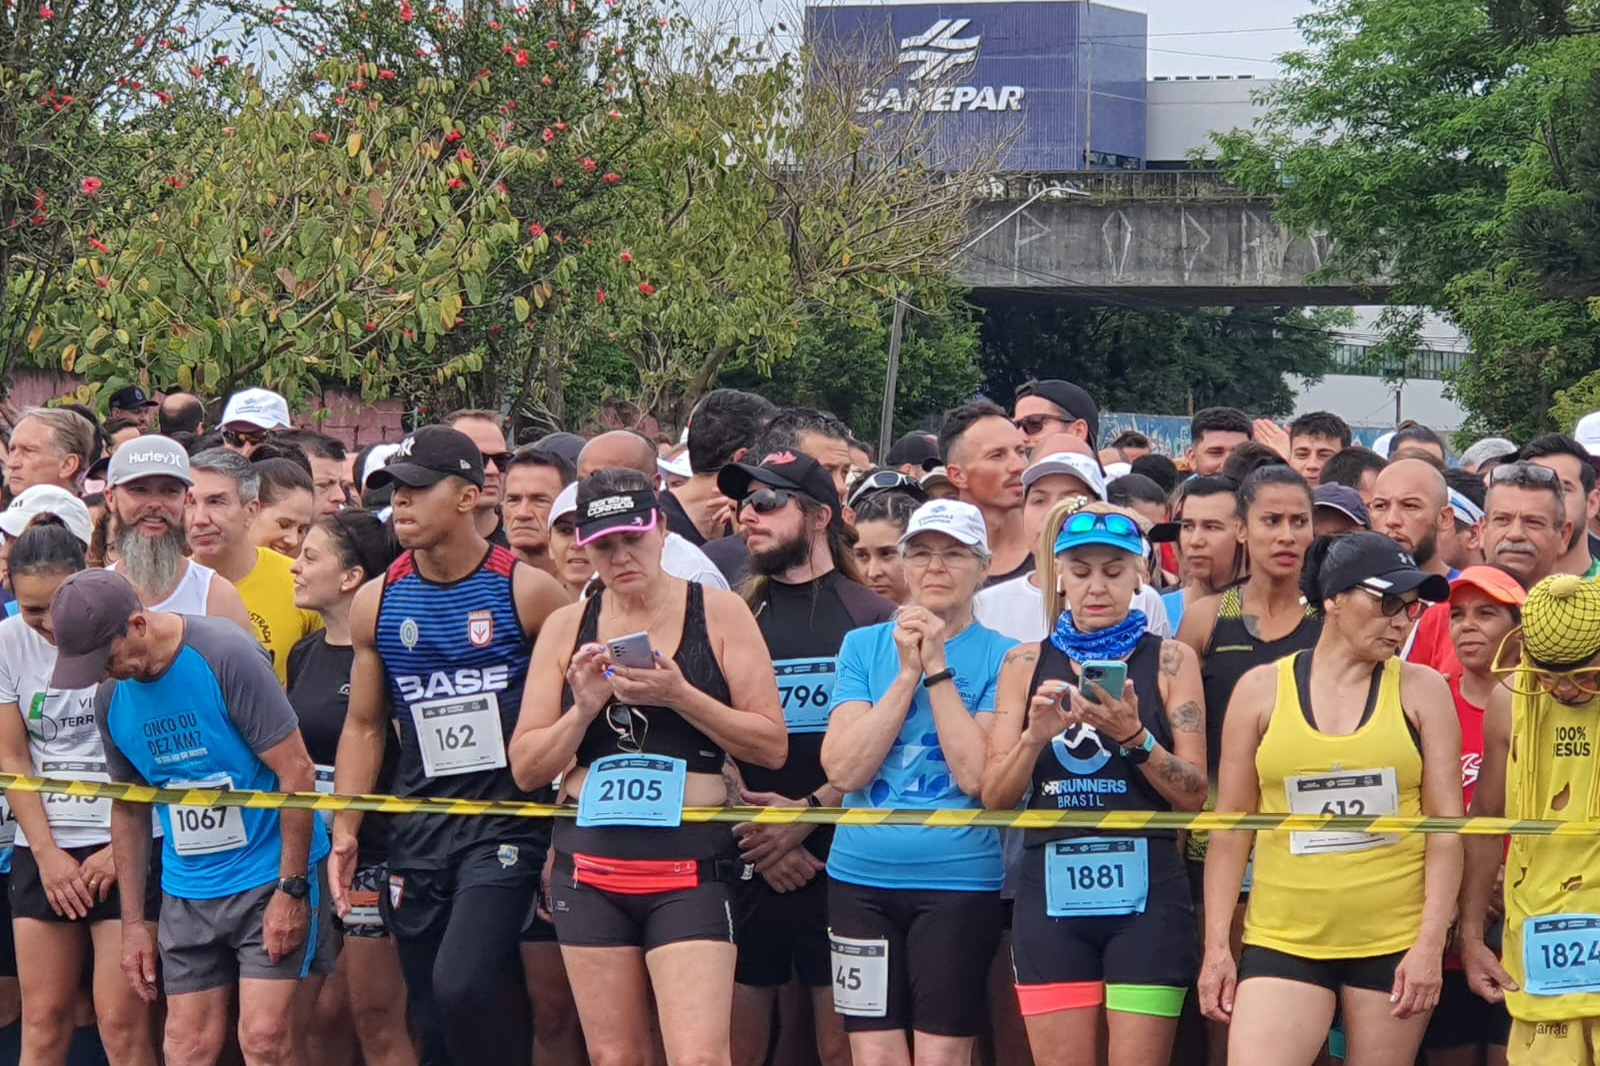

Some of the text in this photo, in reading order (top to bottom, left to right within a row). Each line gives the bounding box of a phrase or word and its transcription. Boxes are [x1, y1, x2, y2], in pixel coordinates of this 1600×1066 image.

[856, 86, 1024, 113] SANEPAR
[129, 450, 170, 464] Hurley
[395, 664, 509, 701] BASE
[178, 712, 197, 729] OU
[435, 724, 477, 751] 162
[1555, 725, 1586, 741] 100%
[148, 736, 173, 755] DEZ
[598, 778, 662, 802] 2105
[1057, 794, 1105, 808] BRASIL
[177, 805, 227, 832] 1067
[1066, 863, 1124, 890] 1881
